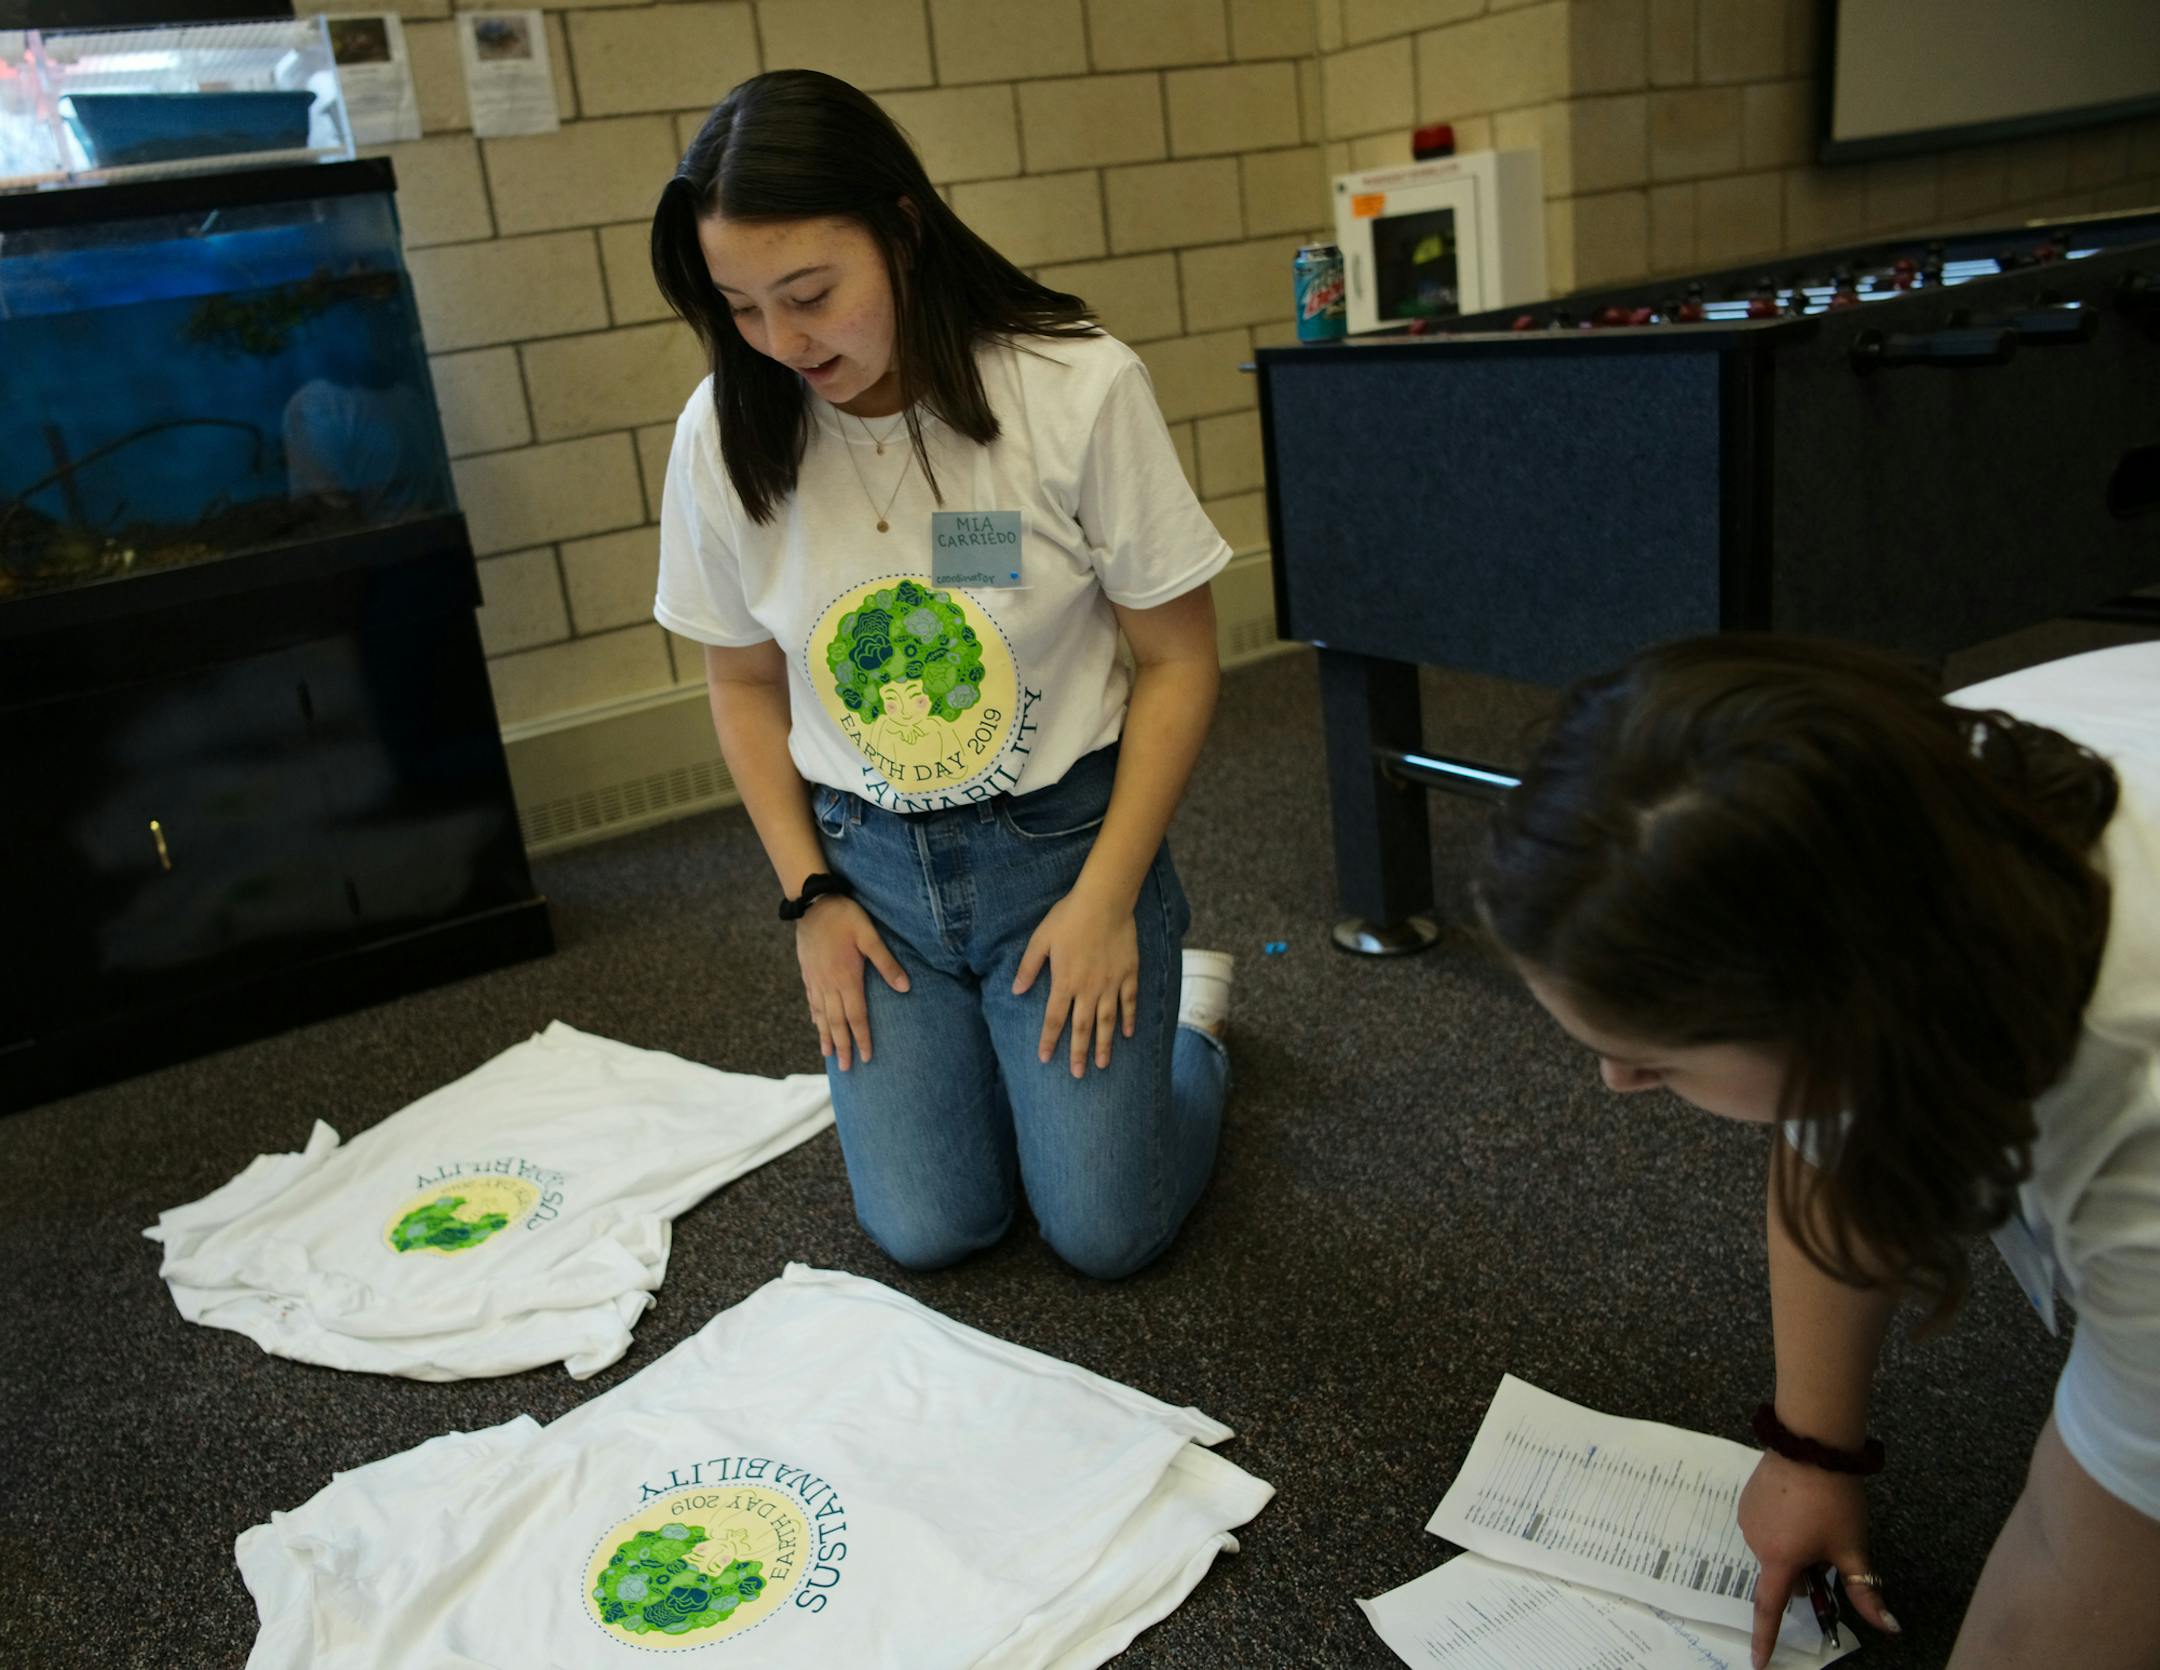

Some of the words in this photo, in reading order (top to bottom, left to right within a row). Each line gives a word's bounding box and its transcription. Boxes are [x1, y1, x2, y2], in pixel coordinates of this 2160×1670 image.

[956, 516, 994, 532] MIA
[937, 531, 1017, 548] CARRIEDO
[840, 713, 905, 781] EARTH
[914, 751, 966, 781] DAY
[967, 708, 1002, 755] 2019
[671, 1494, 720, 1516] 2019
[726, 1494, 777, 1519] DAY
[639, 1456, 848, 1614] SUSTAINABILITY
[769, 1513, 797, 1580] EARTH
